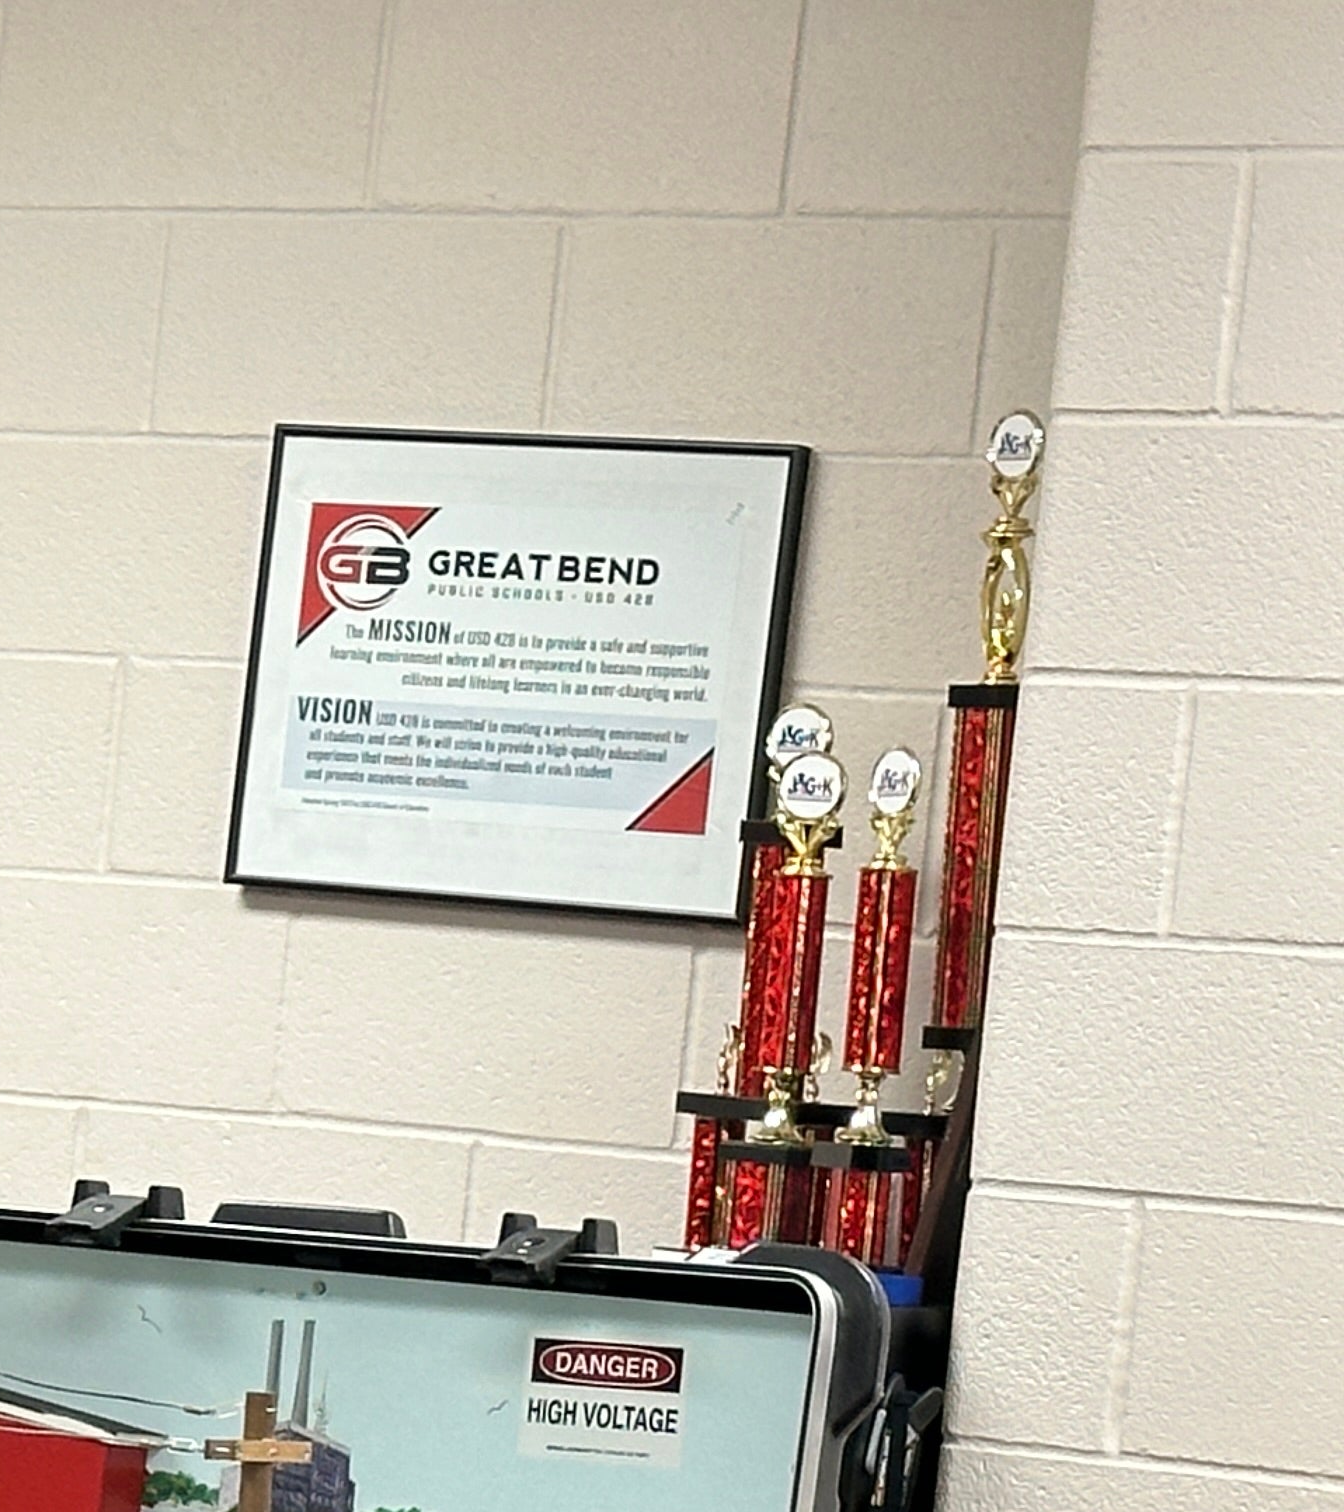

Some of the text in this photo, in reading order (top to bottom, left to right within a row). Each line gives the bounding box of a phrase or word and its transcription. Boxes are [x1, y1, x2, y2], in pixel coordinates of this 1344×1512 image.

[428, 549, 661, 586] GREAT BEND
[427, 583, 484, 598] PUBLIC
[492, 586, 564, 602] SCHOOLS
[584, 590, 615, 604] USD
[368, 618, 452, 644] MISSION
[297, 696, 373, 726] VISION
[554, 1351, 659, 1380] DANGER
[527, 1397, 679, 1434] HIGH VOLTAGE
